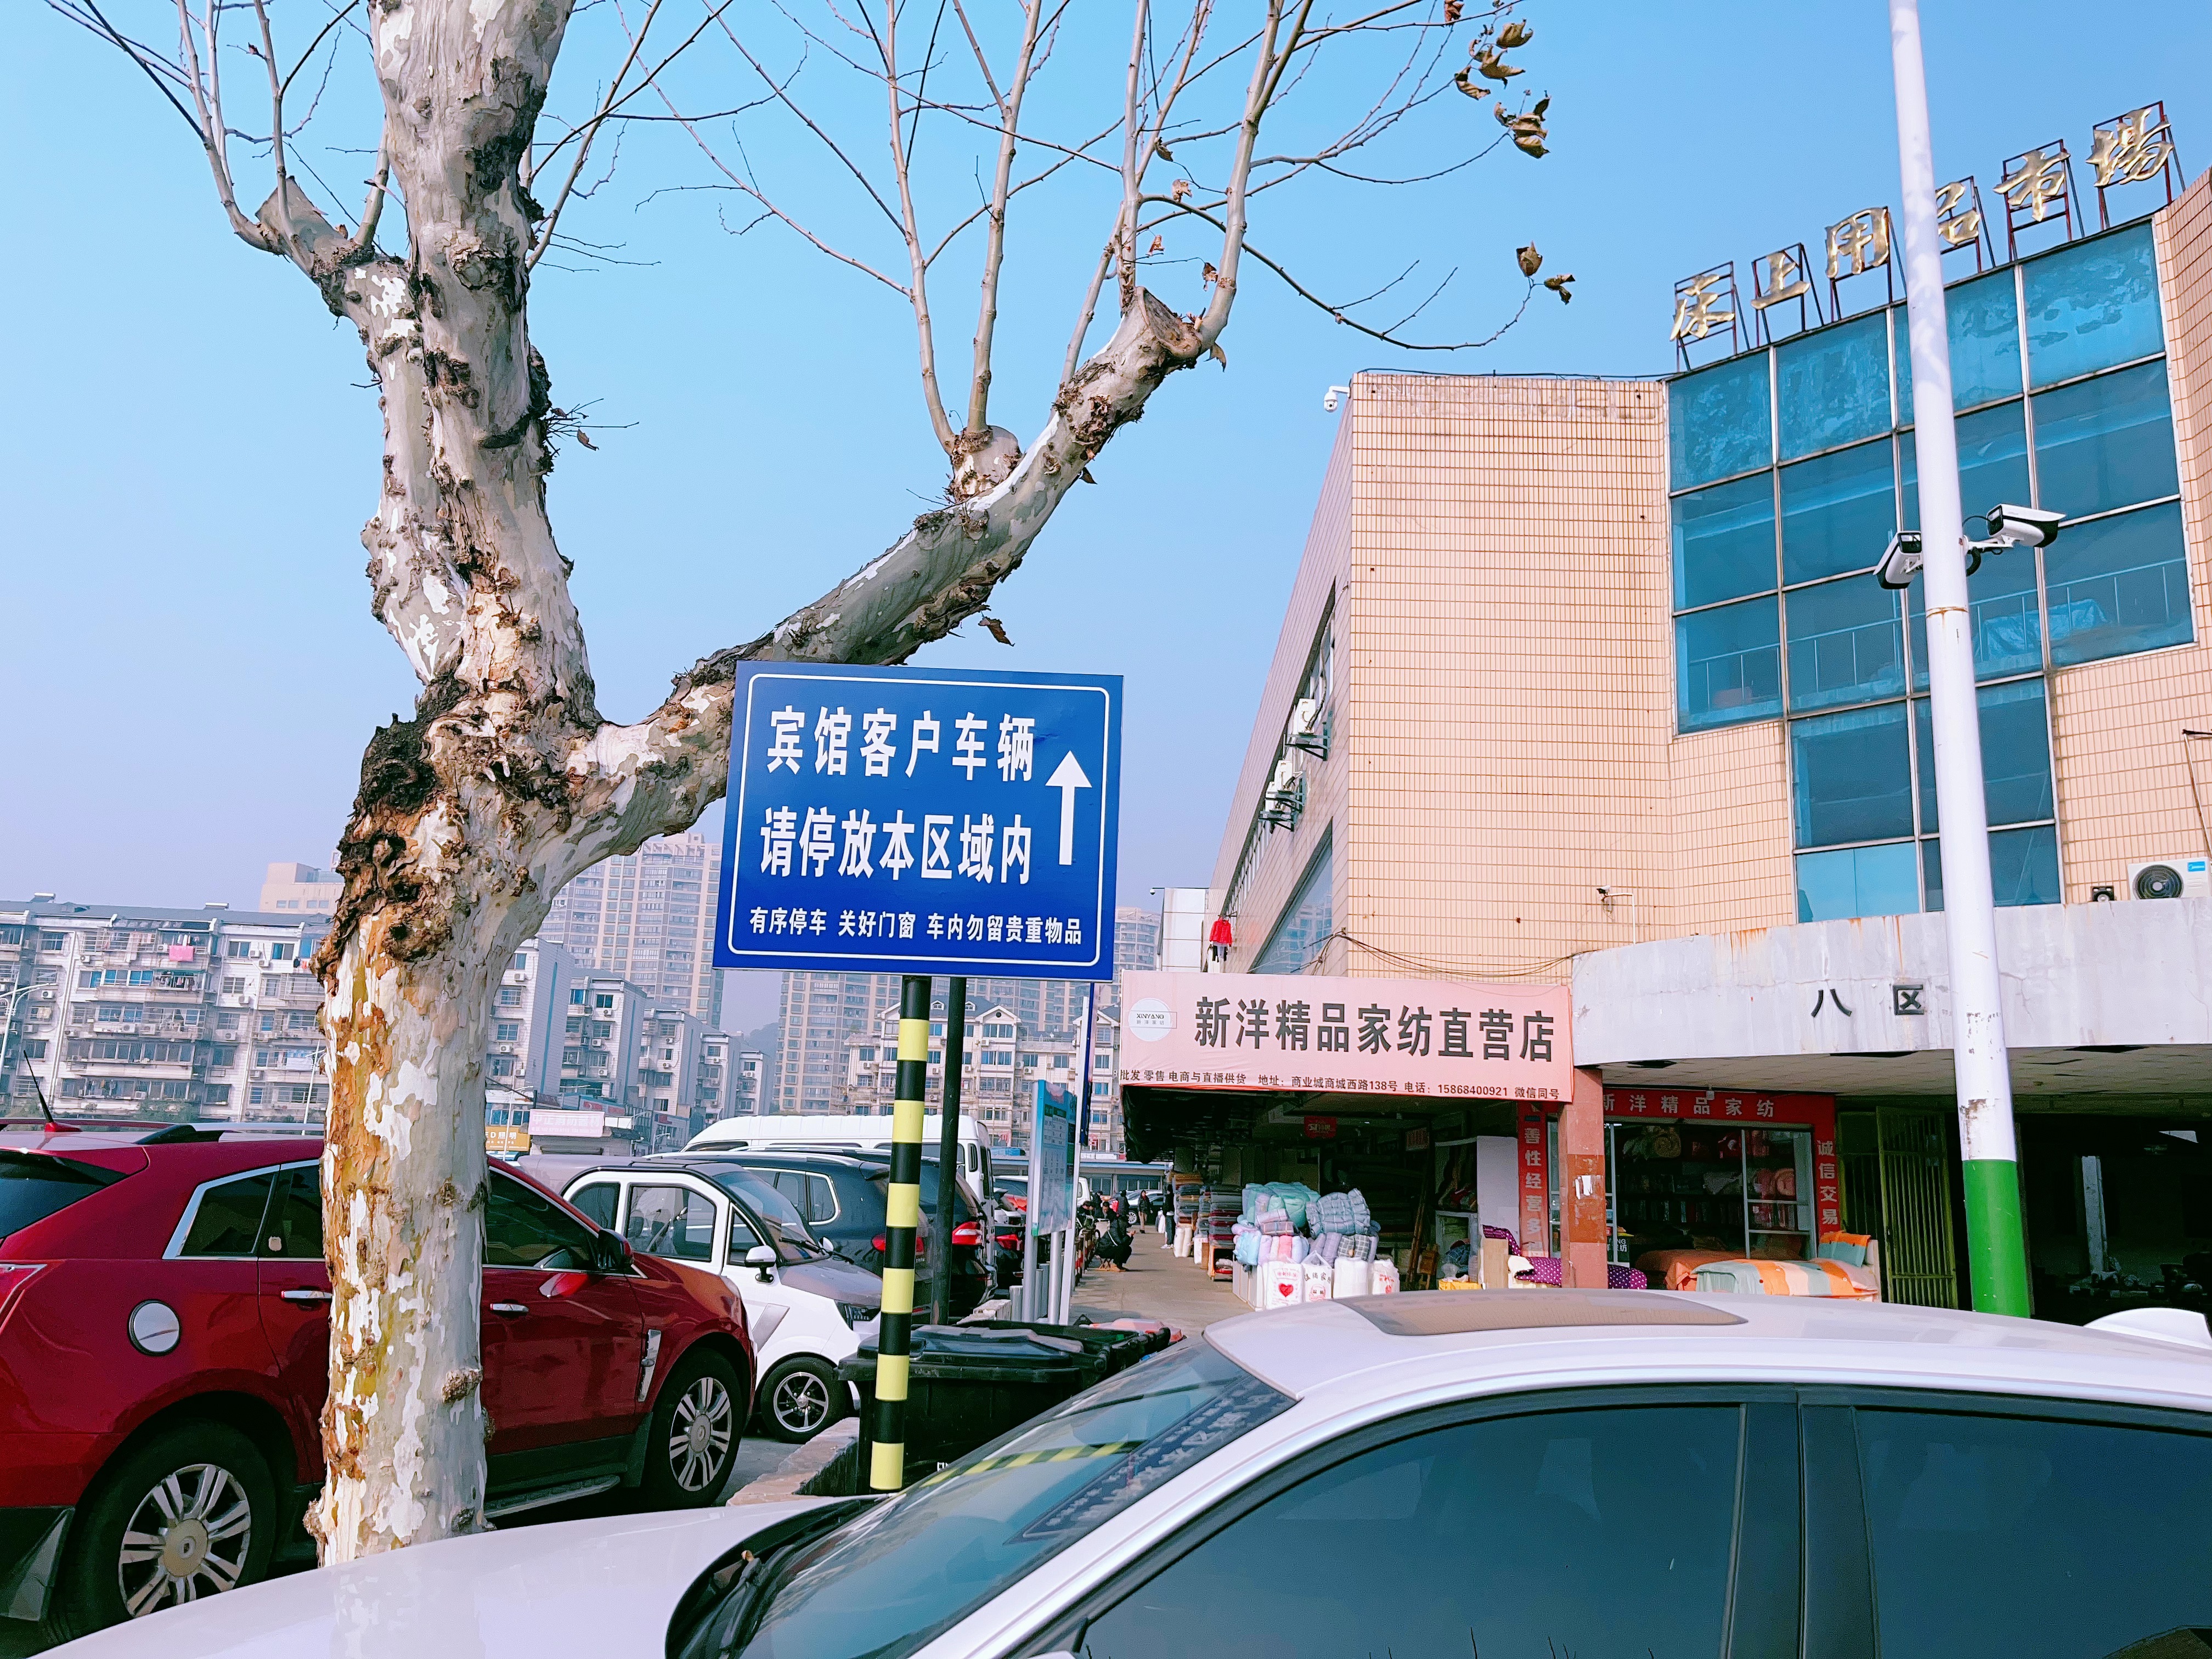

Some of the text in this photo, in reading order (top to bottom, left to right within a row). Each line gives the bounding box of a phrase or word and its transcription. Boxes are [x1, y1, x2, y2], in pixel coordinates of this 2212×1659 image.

[768, 706, 1035, 781] 宾馆客户车辆
[760, 806, 1031, 884] 请停放本区域内
[749, 906, 1081, 944] 有序停车 关好门窗 车内勿留贵重物品
[1194, 996, 1554, 1062] 新洋精品家纺直营店
[1811, 984, 1924, 1018] 八区
[1120, 1070, 1140, 1081] 批发
[1144, 1070, 1165, 1082] 零售
[1169, 1070, 1246, 1084] 电商与直播供货
[1514, 1087, 1559, 1100] 微信同号
[1817, 1140, 1838, 1234] 诚信交易
